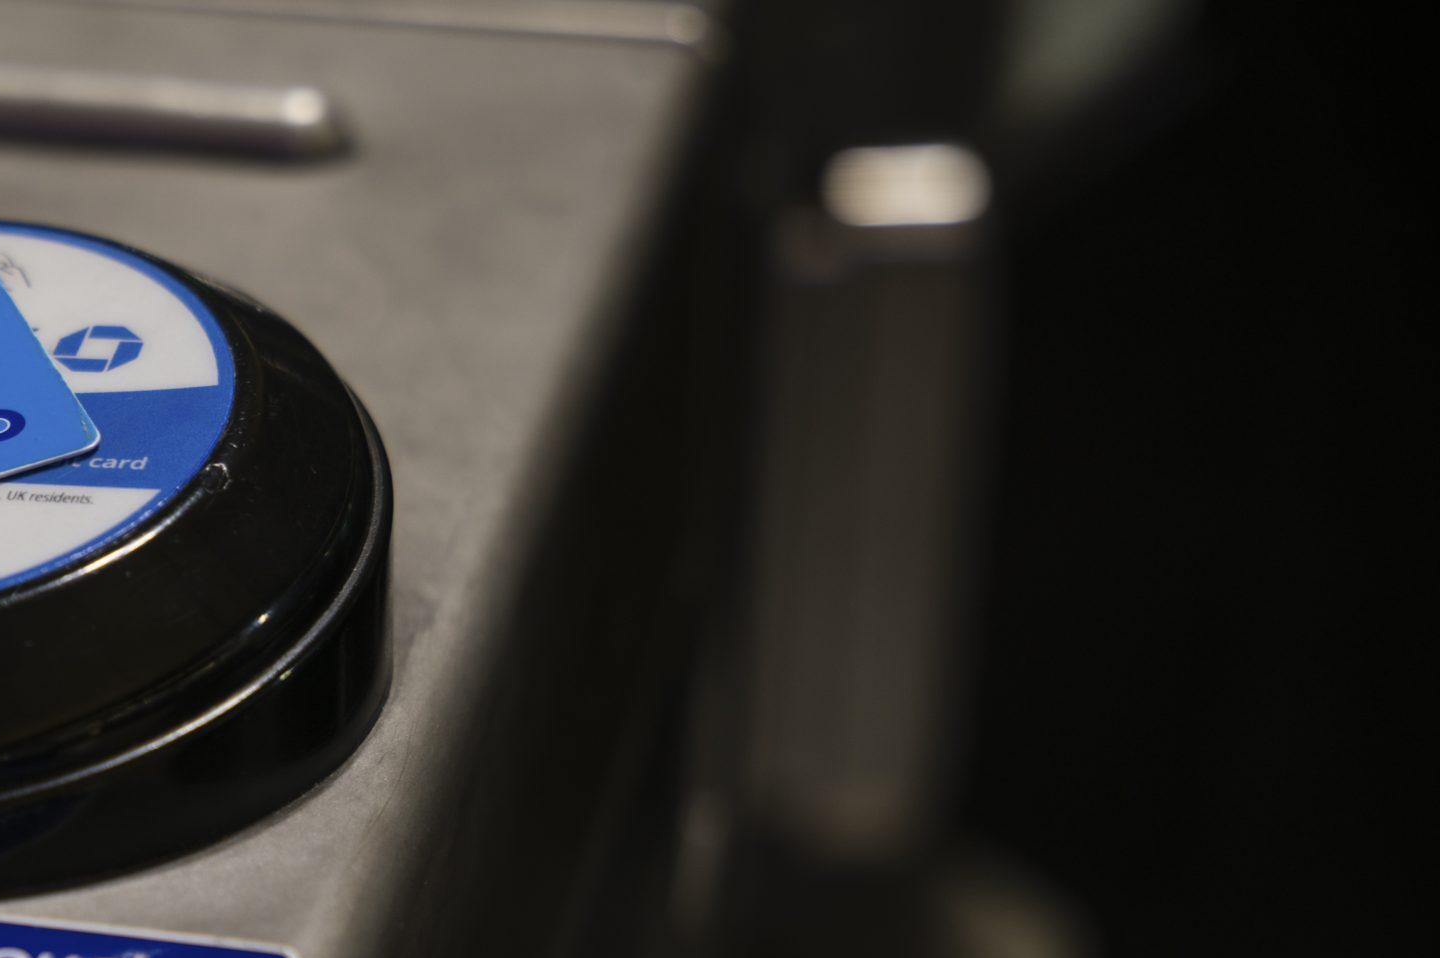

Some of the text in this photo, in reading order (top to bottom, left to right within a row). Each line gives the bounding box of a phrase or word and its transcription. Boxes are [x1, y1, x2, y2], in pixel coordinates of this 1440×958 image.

[89, 456, 149, 470] card
[6, 490, 28, 502] UK
[29, 491, 96, 505] residents.
